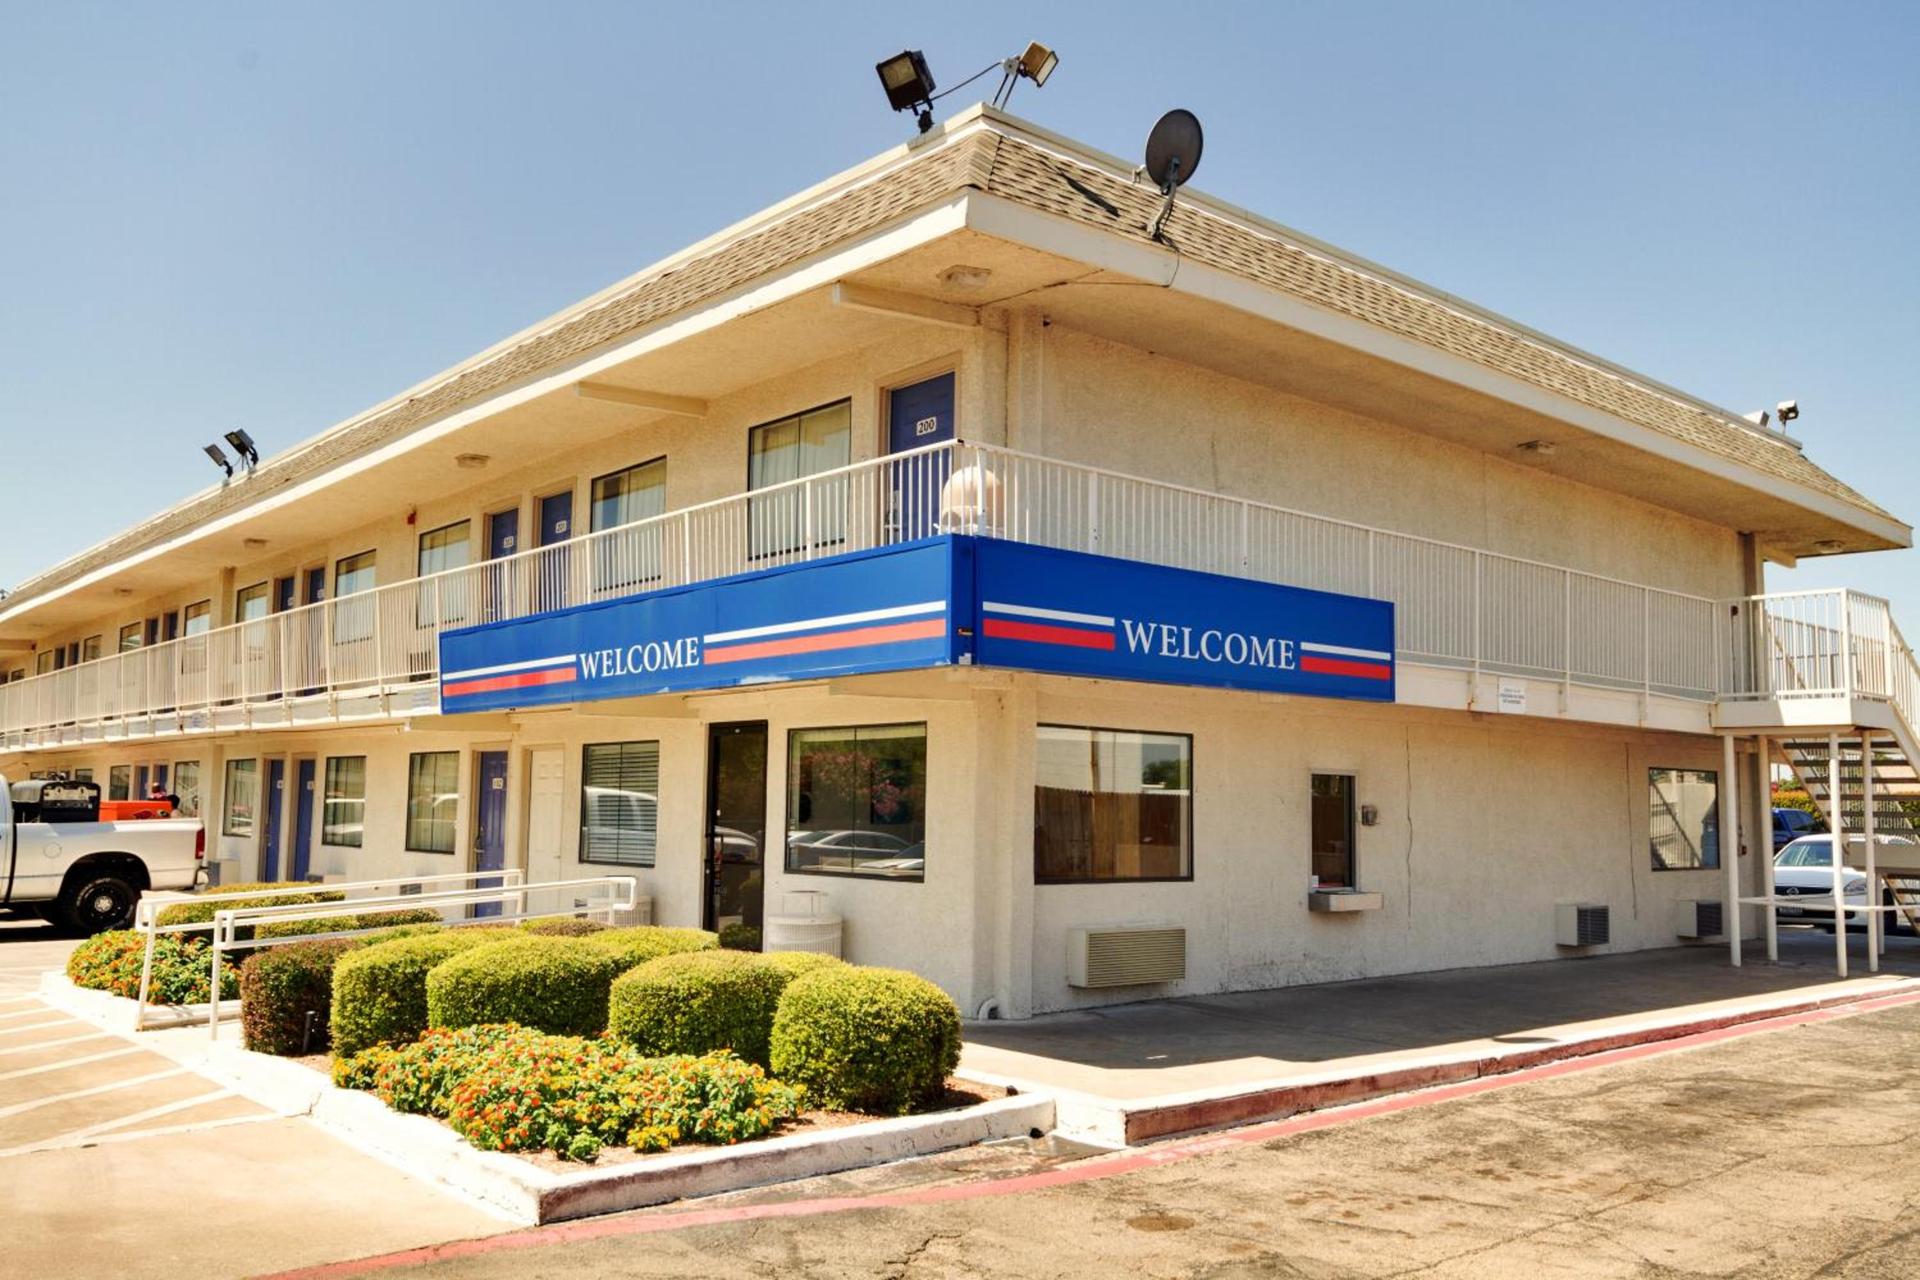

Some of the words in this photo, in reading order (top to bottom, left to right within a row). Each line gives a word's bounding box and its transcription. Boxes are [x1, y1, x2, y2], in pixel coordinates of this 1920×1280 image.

[918, 419, 935, 433] 200
[579, 637, 700, 680] WELCOME
[1121, 619, 1296, 670] WELCOME
